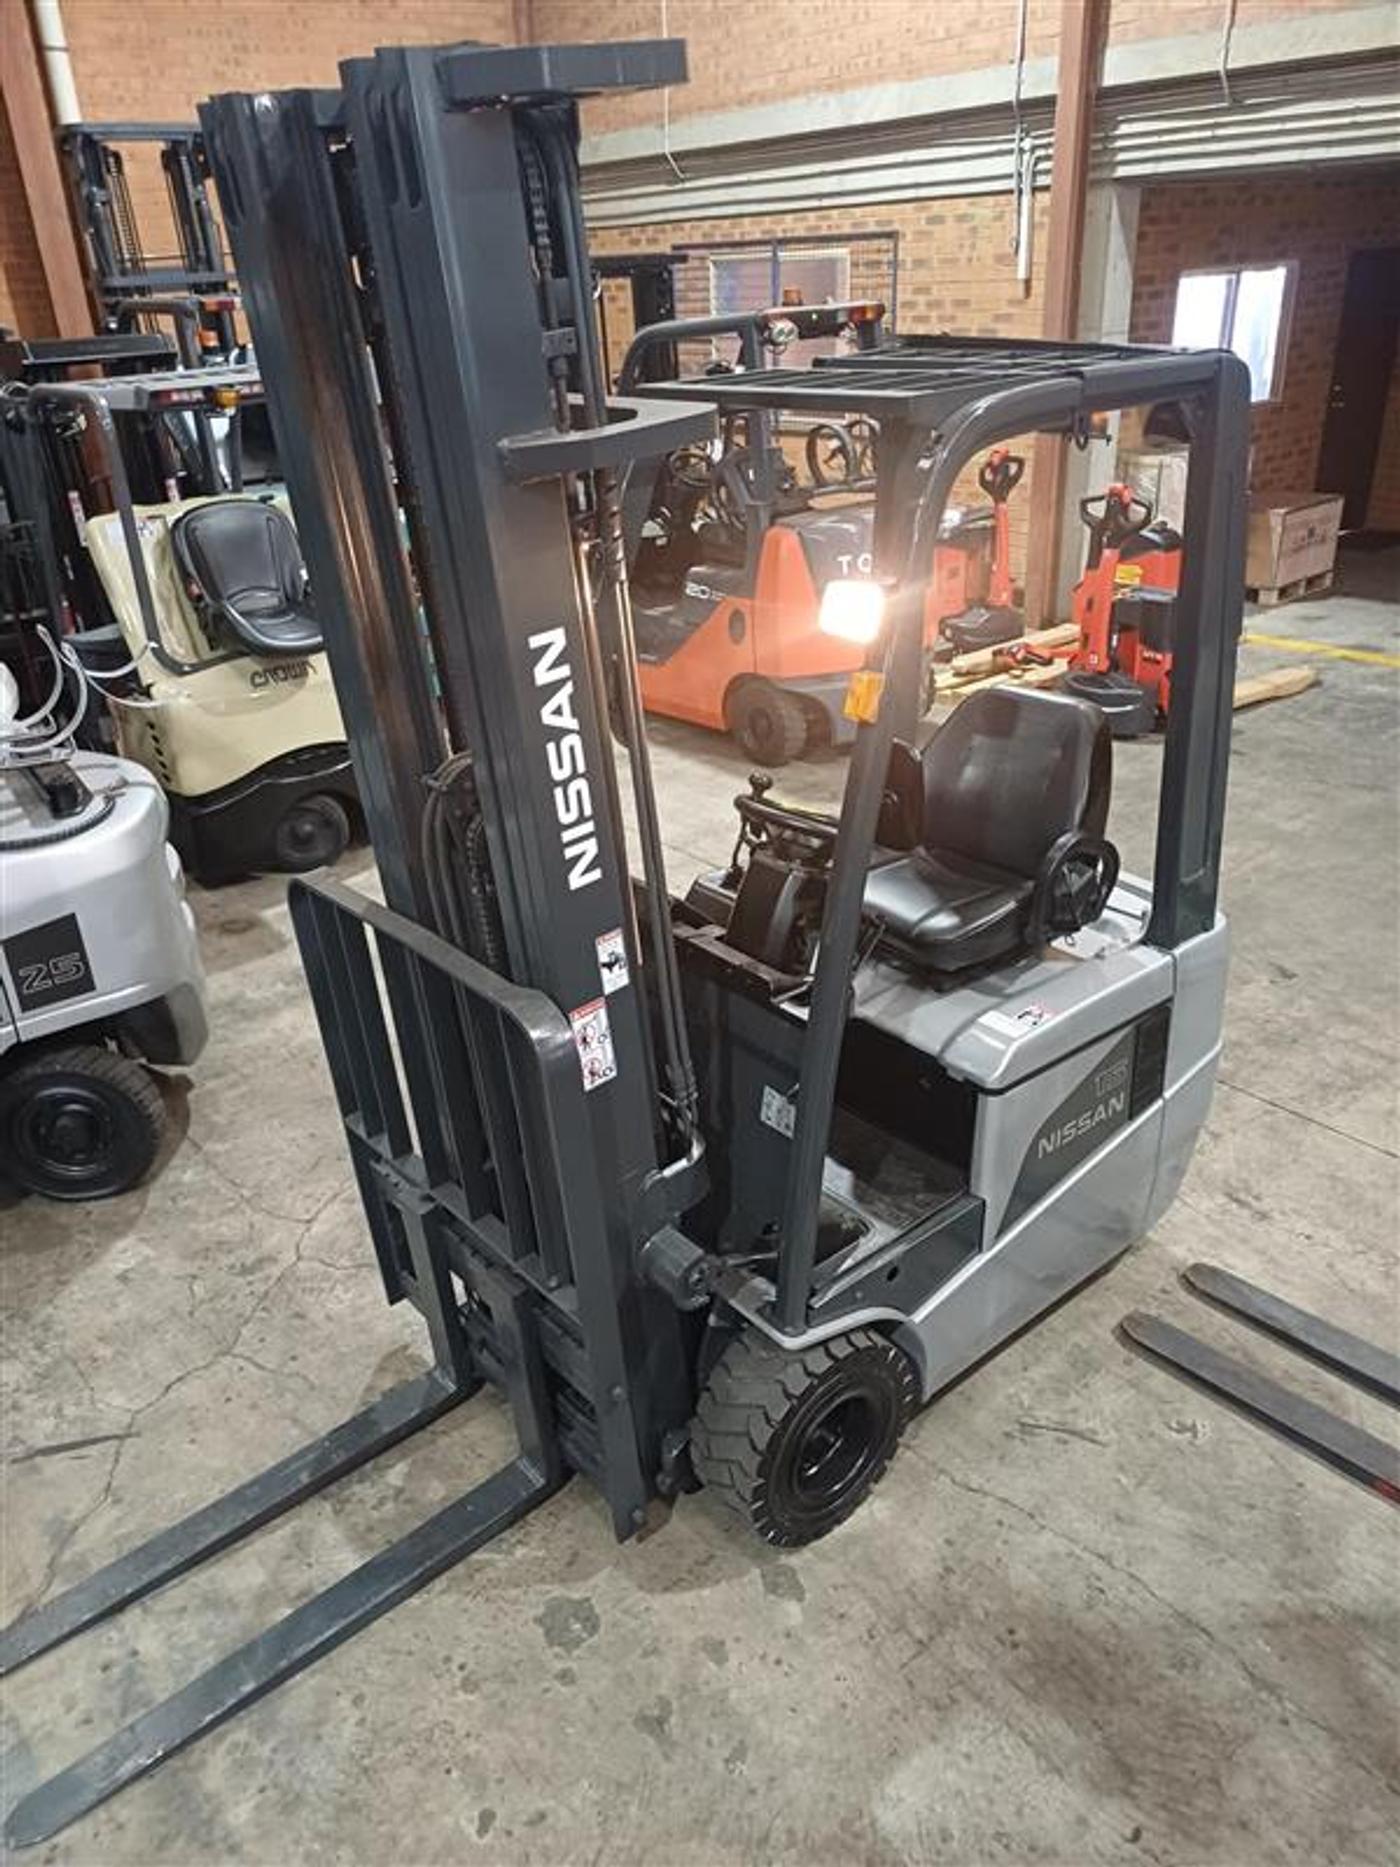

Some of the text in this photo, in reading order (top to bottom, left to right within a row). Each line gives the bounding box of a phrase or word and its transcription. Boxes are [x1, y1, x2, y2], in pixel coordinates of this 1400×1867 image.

[527, 627, 602, 891] NISSAN
[18, 952, 85, 994] 25
[1038, 1091, 1125, 1159] NISSAN
